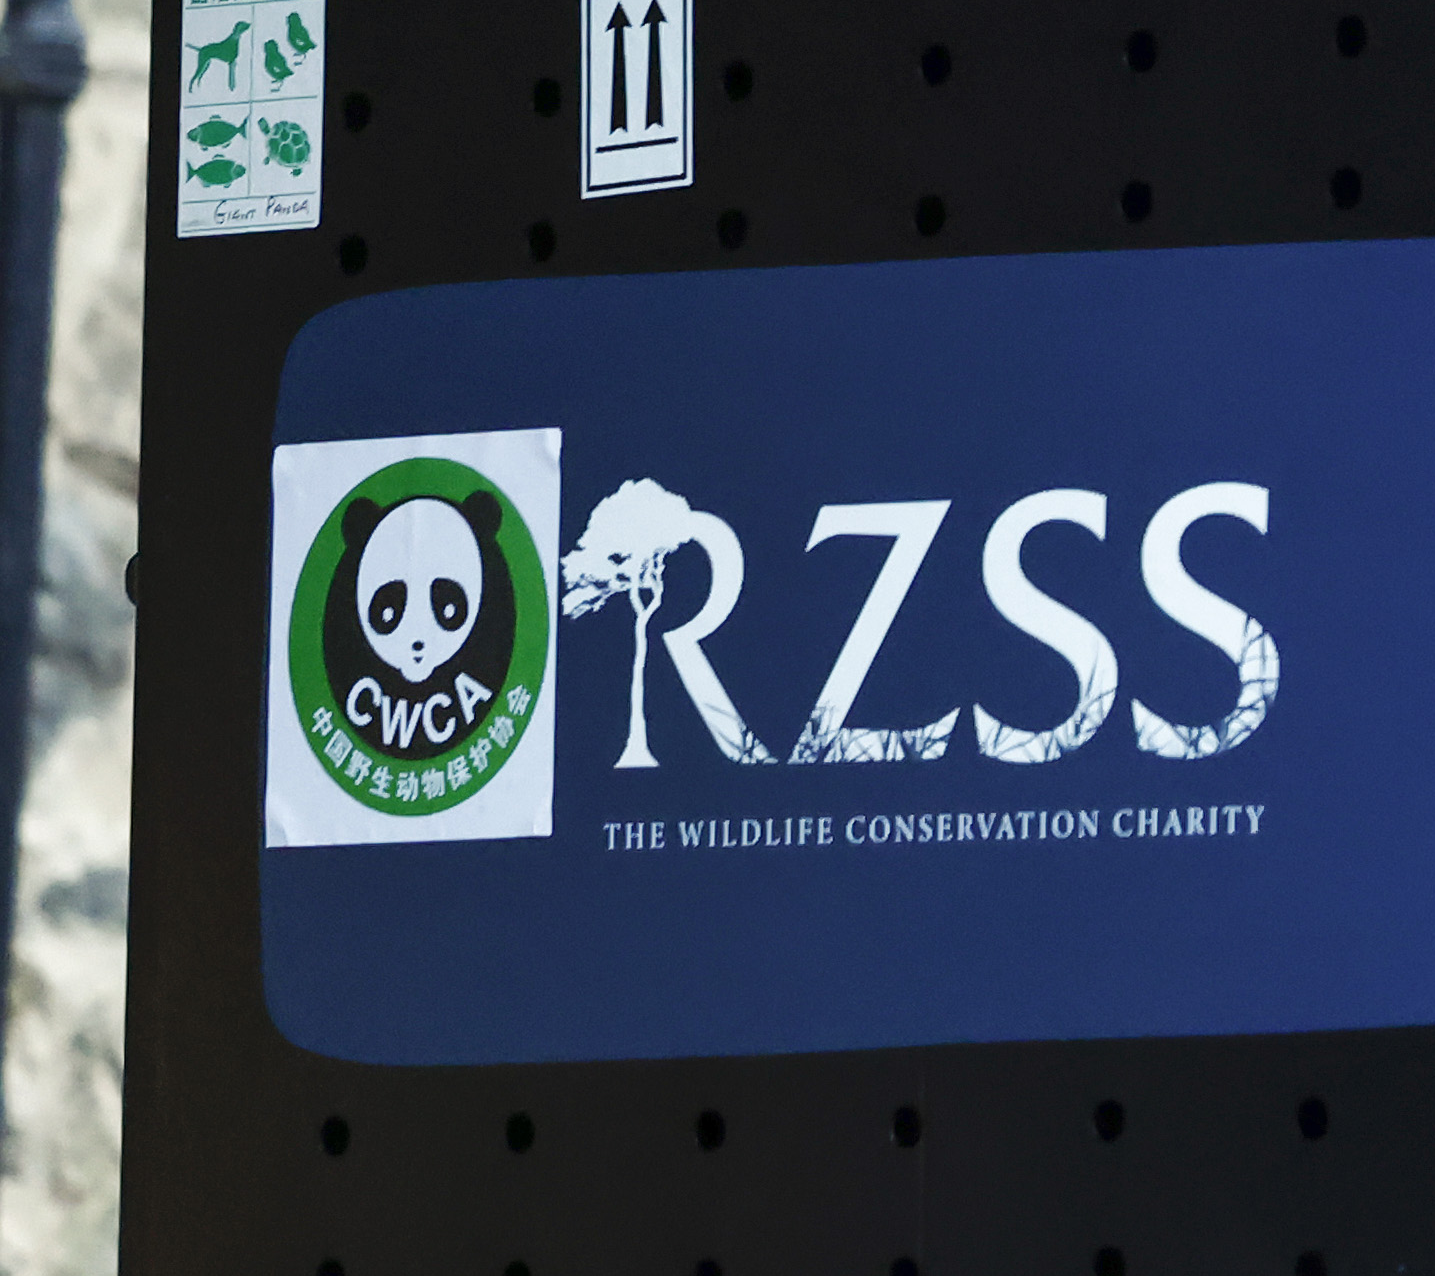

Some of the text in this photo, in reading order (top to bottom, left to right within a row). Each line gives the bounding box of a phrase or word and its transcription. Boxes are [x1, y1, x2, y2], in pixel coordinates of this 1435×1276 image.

[561, 477, 1280, 767] RZSS
[346, 671, 493, 749] CWCA
[603, 804, 1266, 851] THE WILDLIFE CONSERVATION CHARITY
